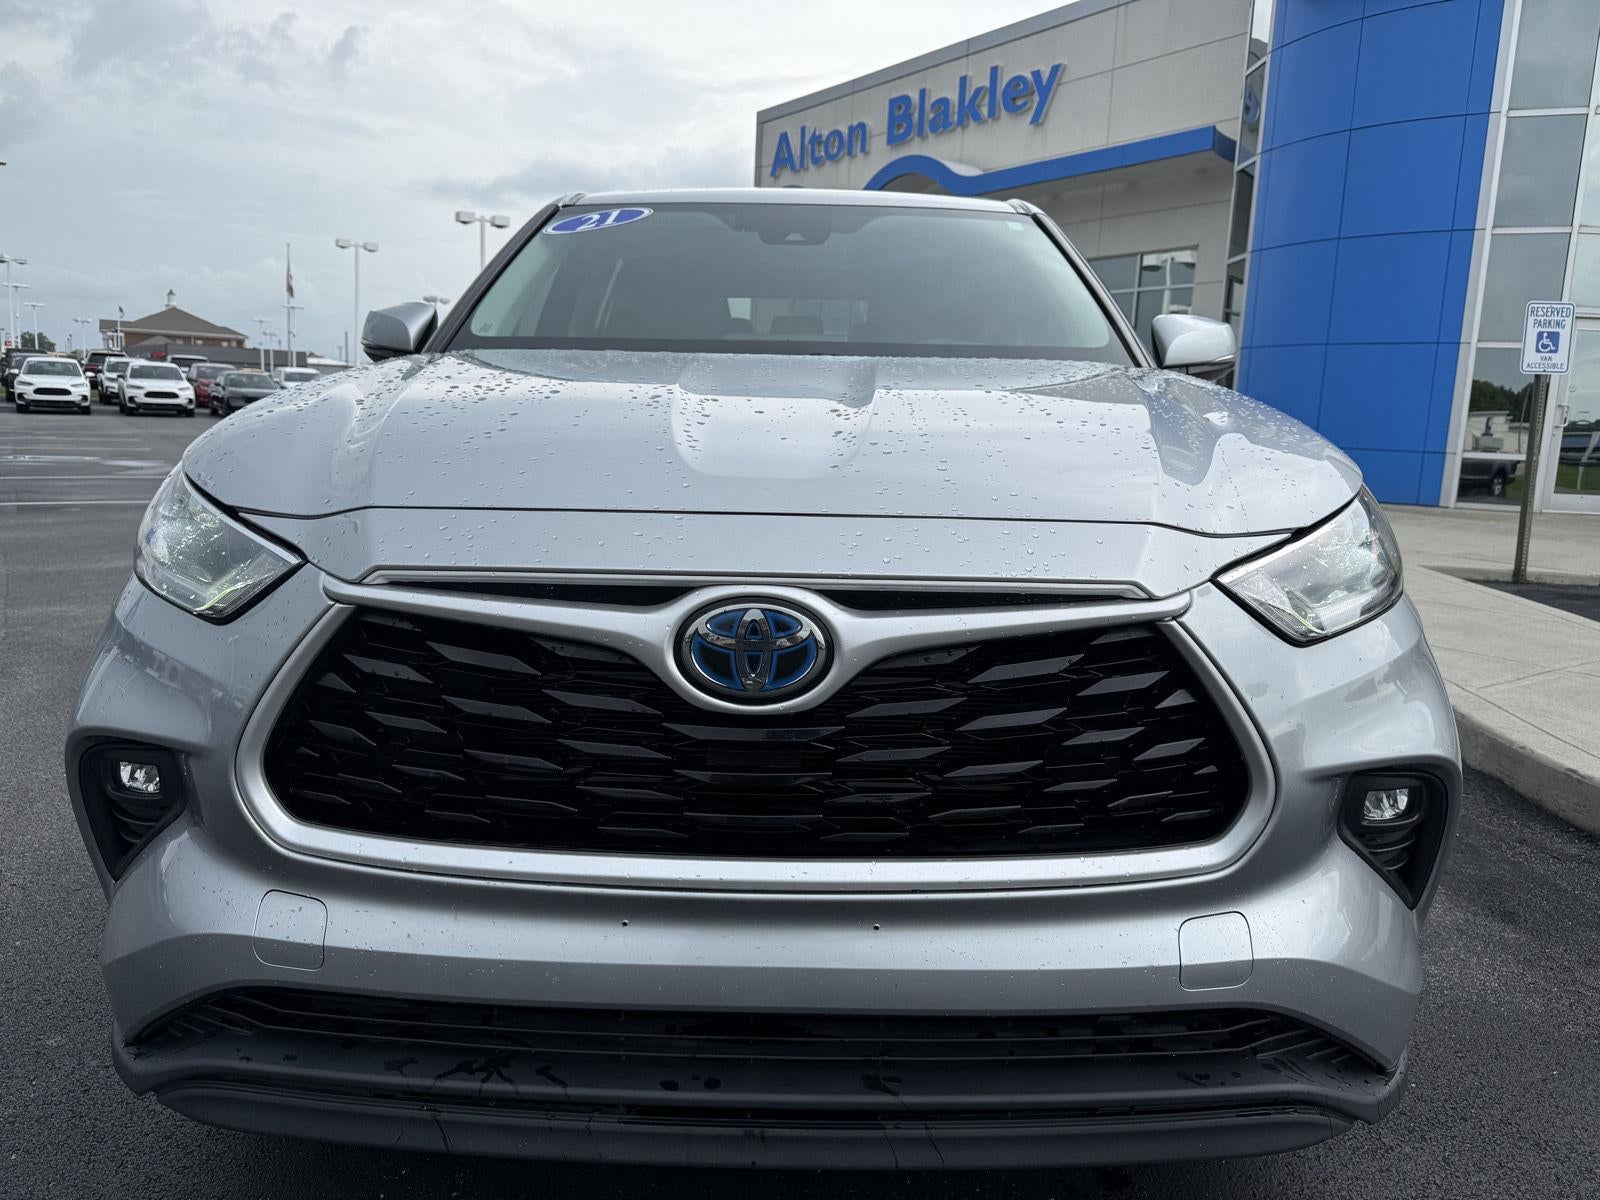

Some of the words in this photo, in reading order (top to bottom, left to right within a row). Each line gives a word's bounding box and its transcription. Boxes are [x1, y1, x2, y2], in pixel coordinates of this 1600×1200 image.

[769, 121, 870, 178] Alton
[886, 62, 1067, 147] Blakley
[576, 209, 620, 231] 21
[1530, 306, 1571, 318] RESERVED
[1533, 319, 1566, 329] PARKING
